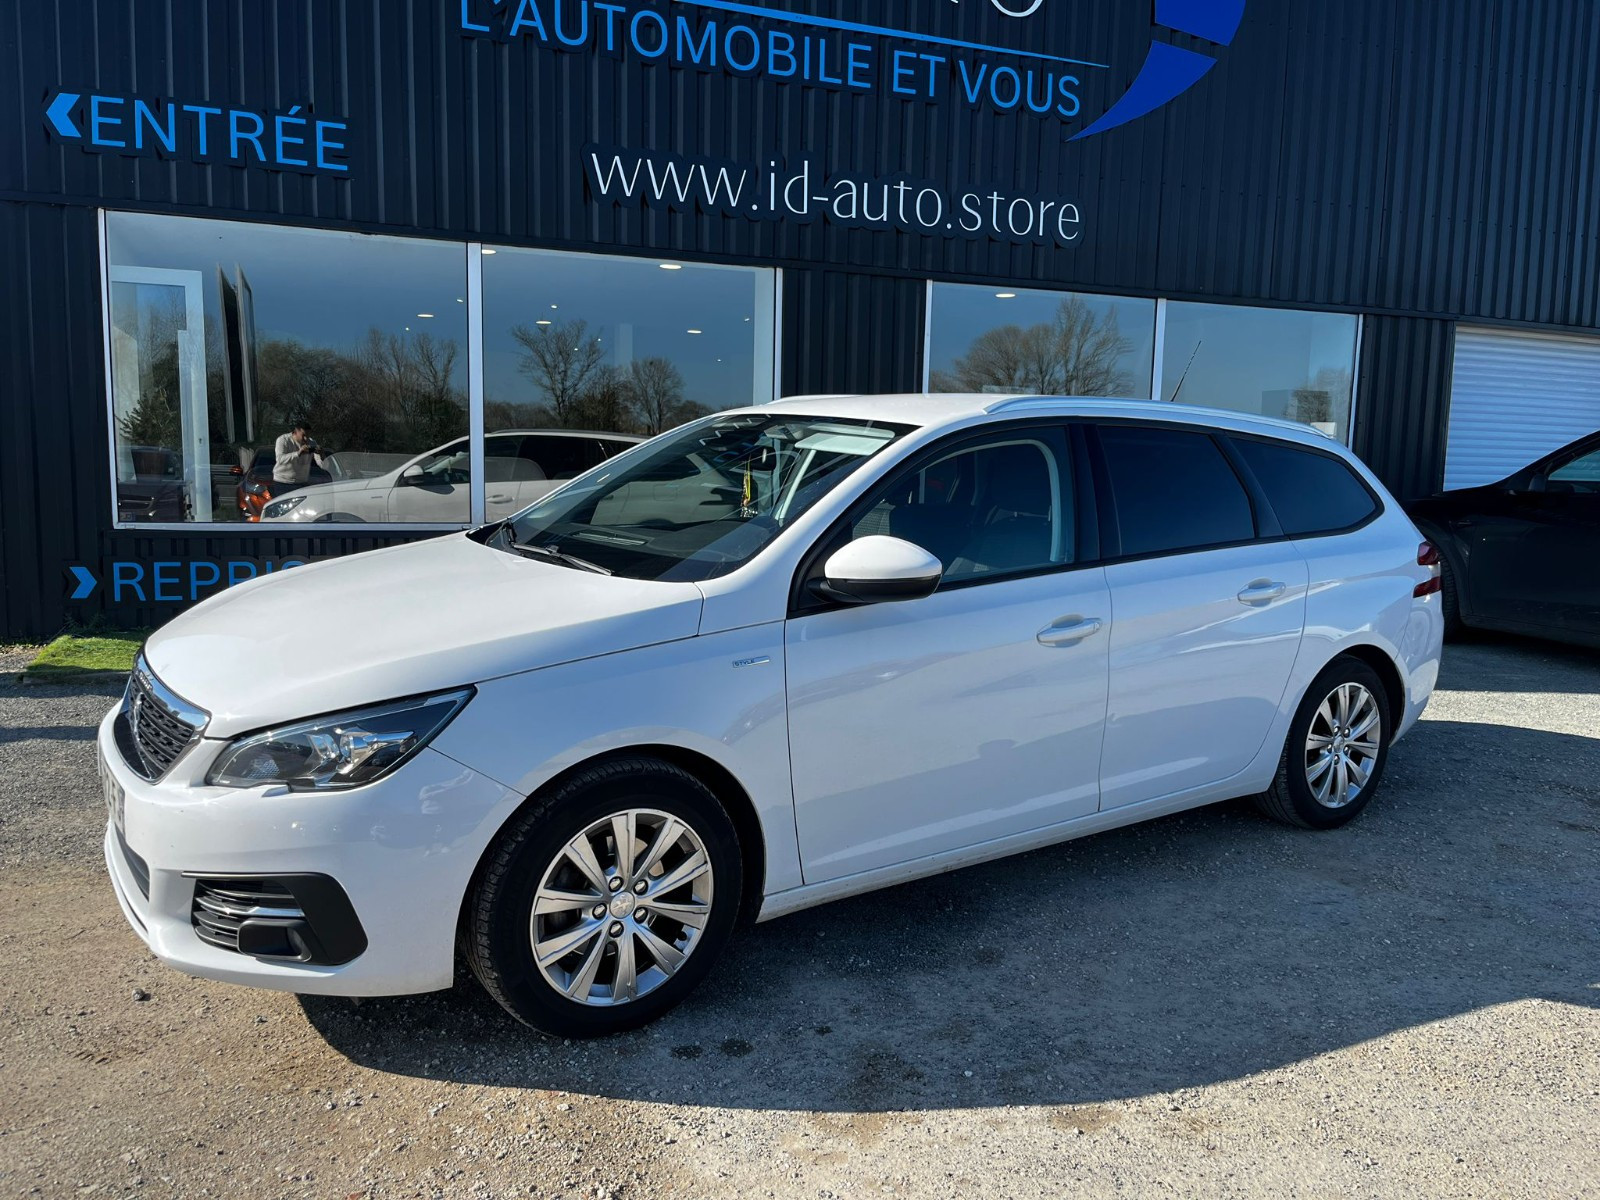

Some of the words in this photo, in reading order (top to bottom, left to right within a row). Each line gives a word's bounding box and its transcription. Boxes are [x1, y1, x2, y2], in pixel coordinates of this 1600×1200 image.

[460, 0, 872, 89] LAUTOMOBILE
[892, 50, 946, 97] ET
[959, 60, 1080, 117] VOUS
[90, 95, 348, 171] ENTRÉE
[591, 153, 1080, 241] www.id-auto.store
